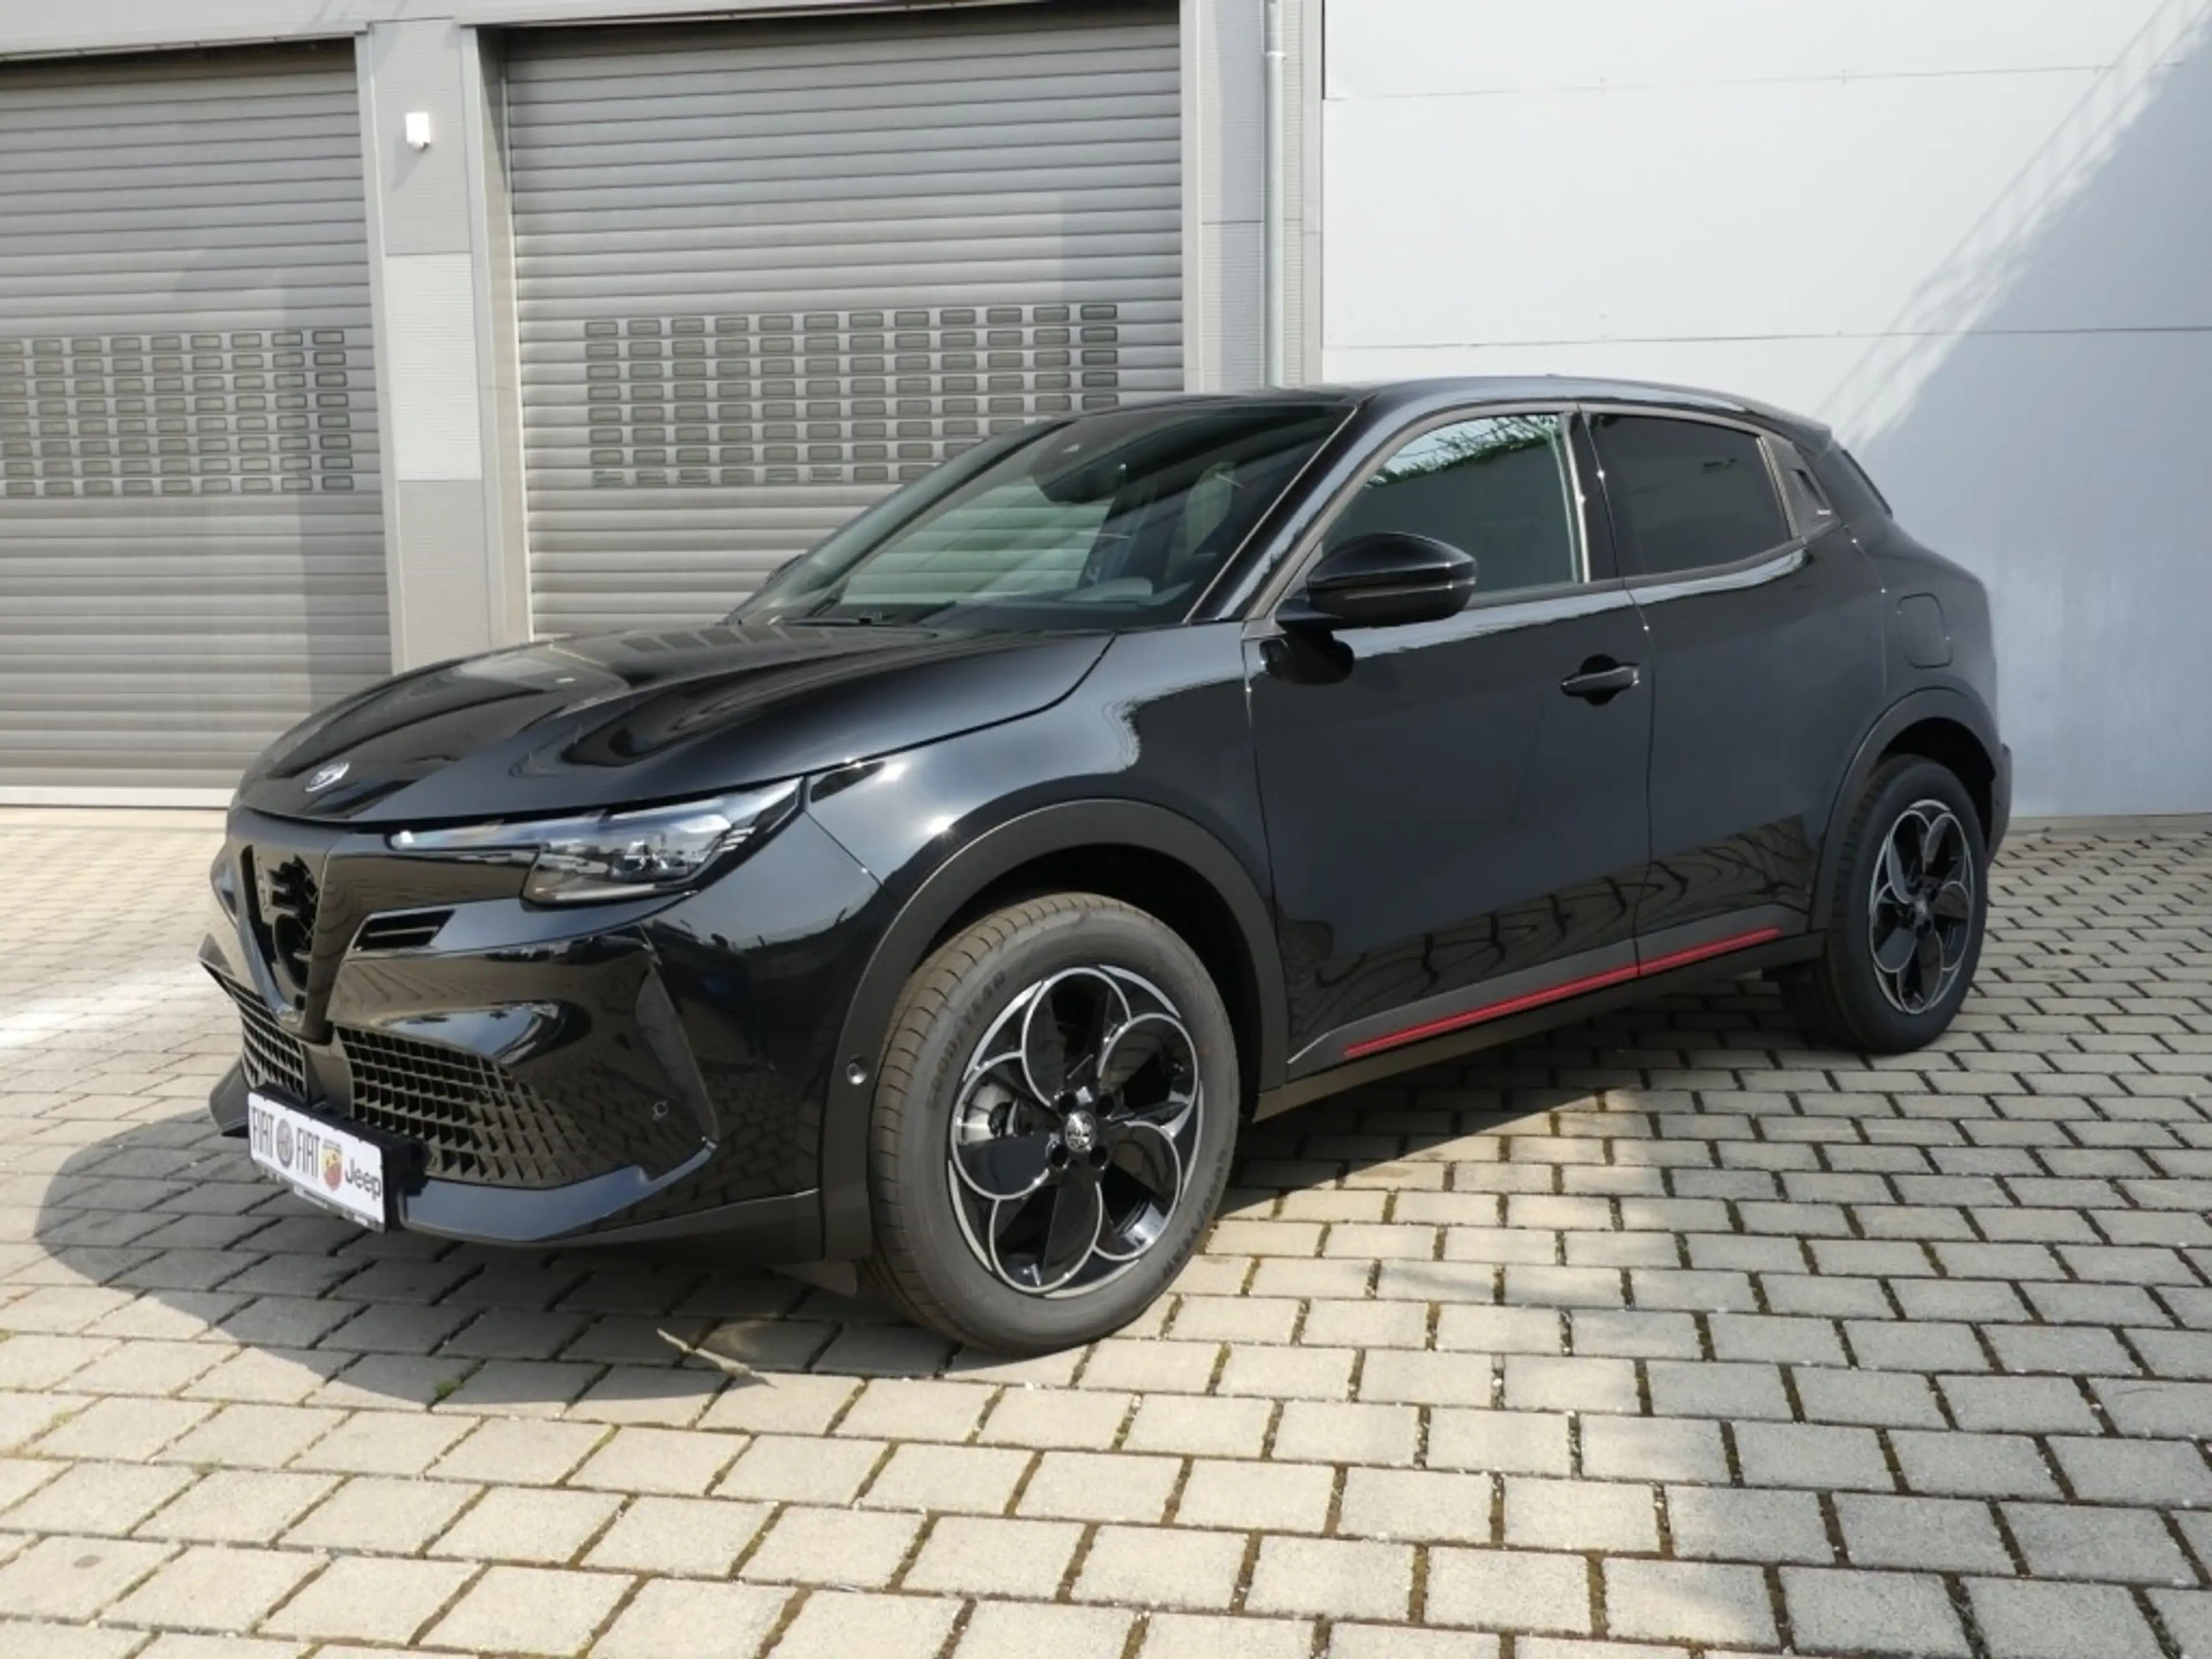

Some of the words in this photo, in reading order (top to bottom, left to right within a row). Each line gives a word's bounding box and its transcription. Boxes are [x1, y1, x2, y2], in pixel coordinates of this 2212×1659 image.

[252, 1107, 274, 1159] FIAT
[297, 1128, 320, 1179] FIAT
[346, 1159, 381, 1200] Jeep
